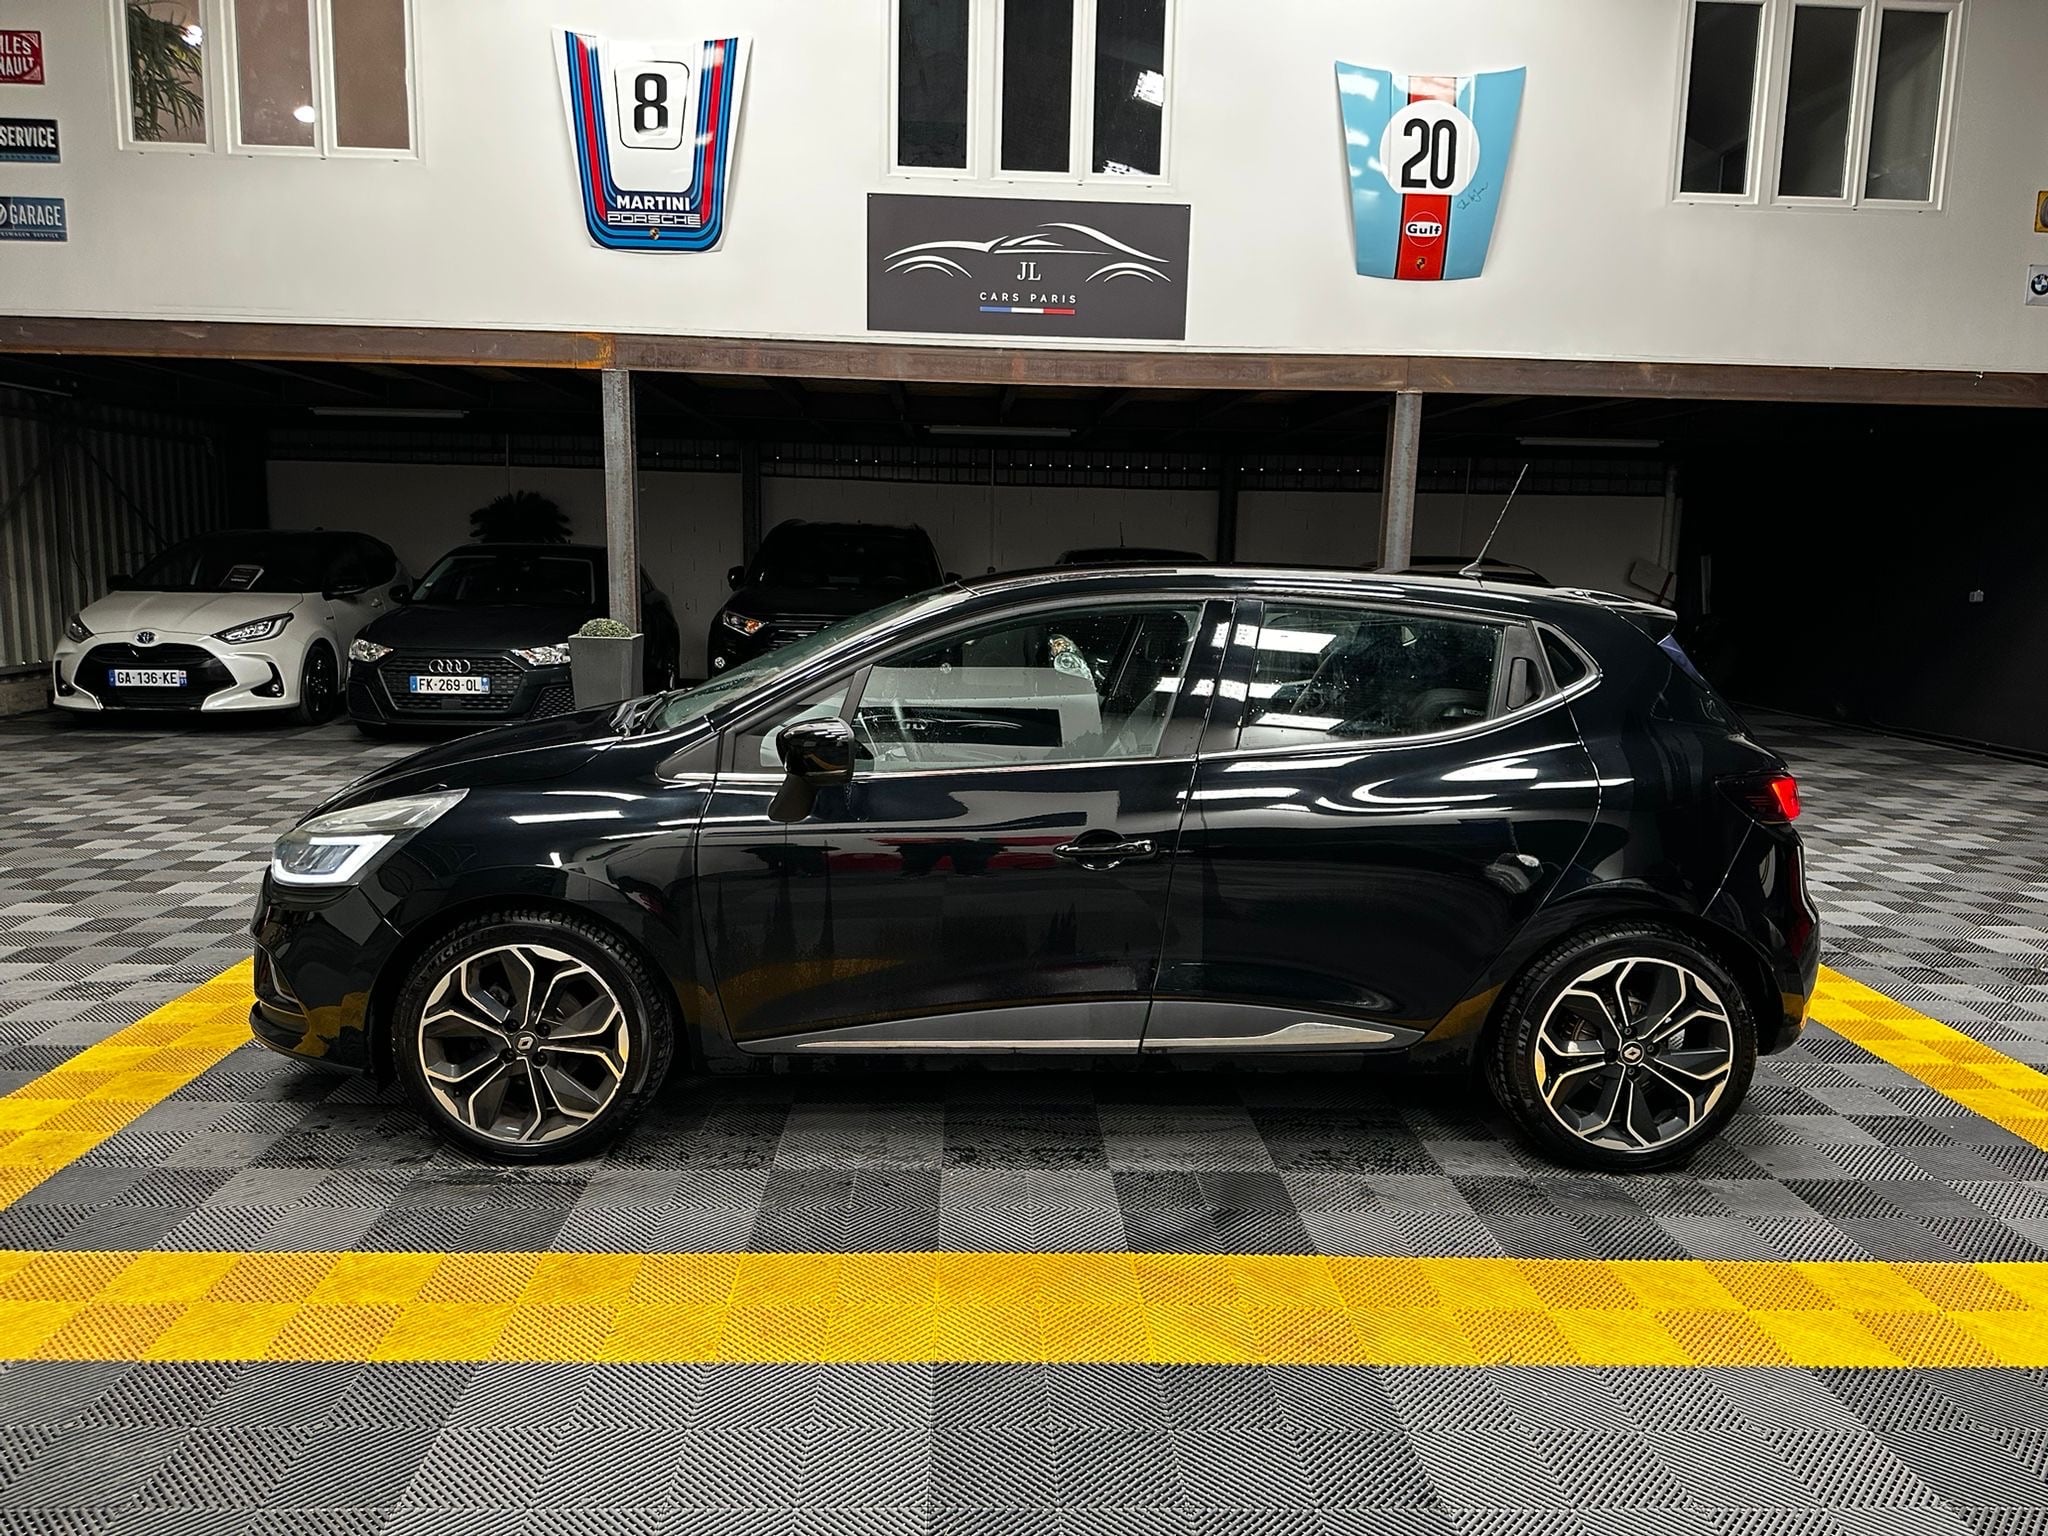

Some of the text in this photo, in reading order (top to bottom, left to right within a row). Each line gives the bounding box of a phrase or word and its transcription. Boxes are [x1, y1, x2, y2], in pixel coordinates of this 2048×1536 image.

[634, 73, 668, 136] 8
[0, 126, 56, 148] SERVICE
[1401, 118, 1457, 189] 20
[616, 194, 690, 211] MARTINI
[10, 204, 62, 226] GARAGE
[607, 213, 701, 225] PORSCHE
[1407, 223, 1440, 235] Gulf
[1016, 261, 1041, 281] JL
[980, 292, 1077, 304] CARS PARIS
[117, 671, 178, 684] GA-136-KE
